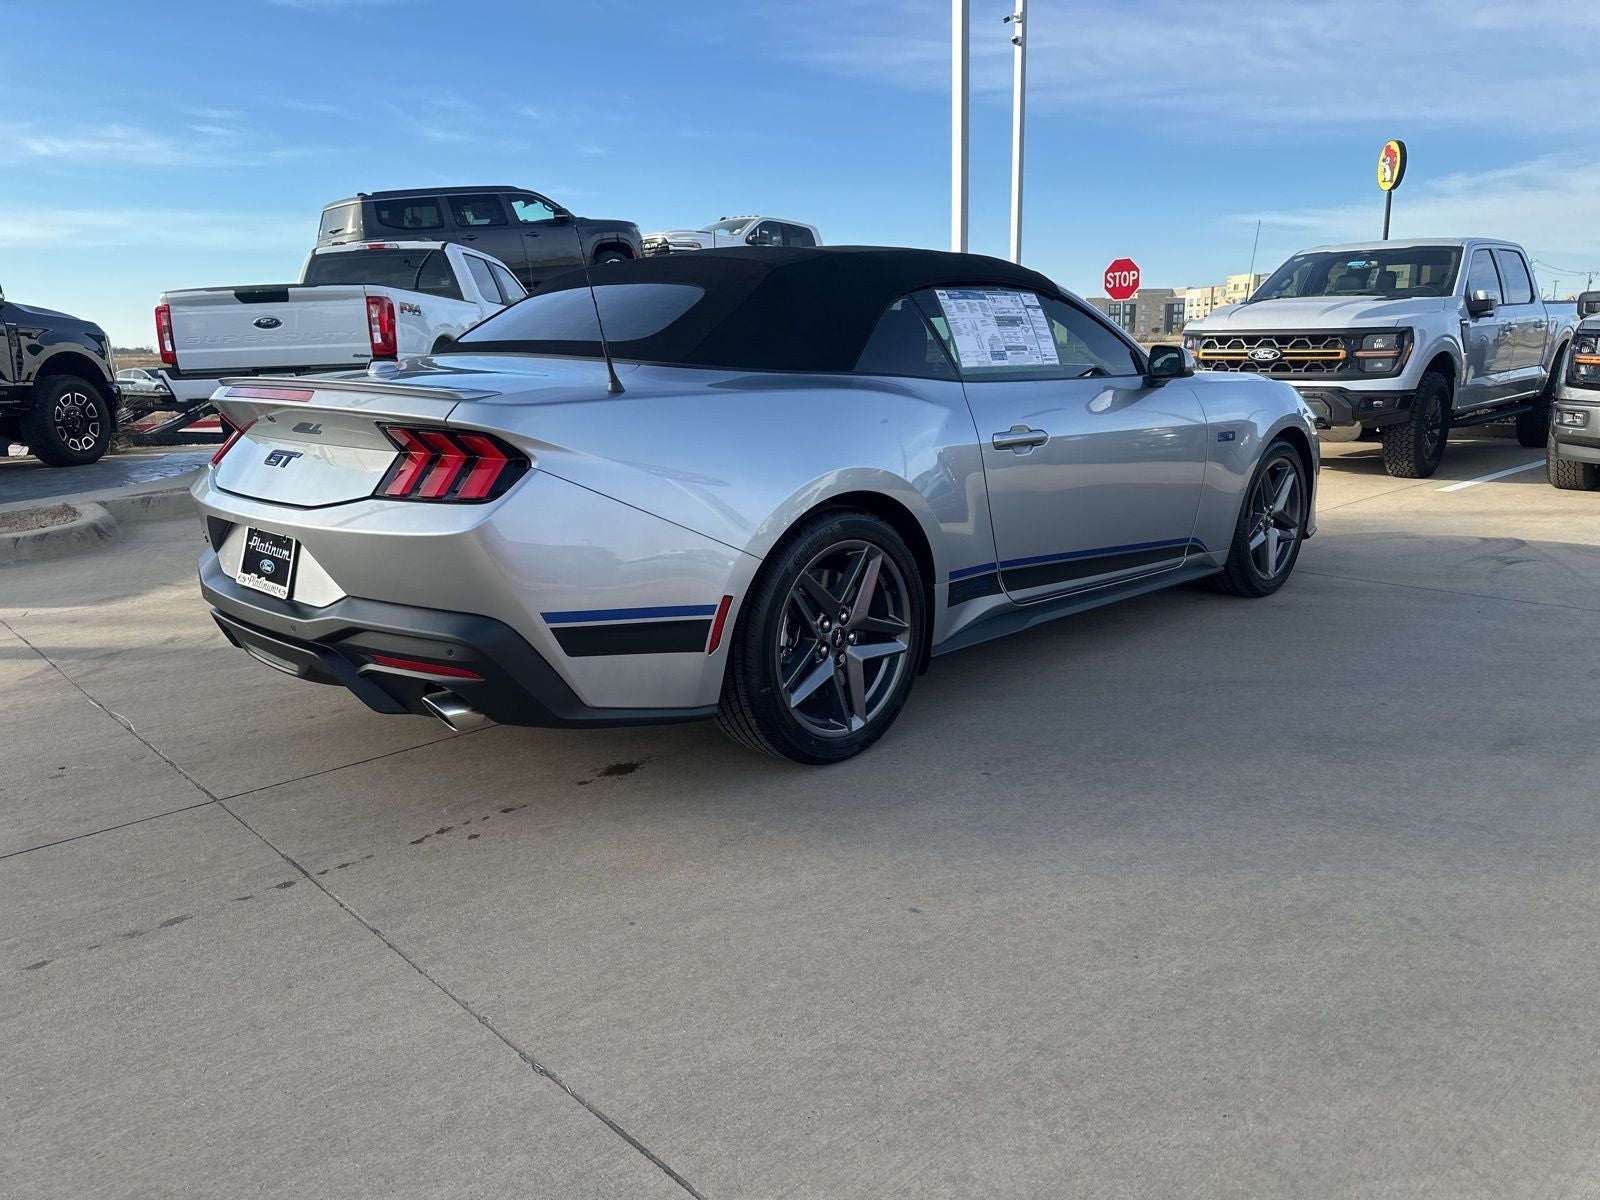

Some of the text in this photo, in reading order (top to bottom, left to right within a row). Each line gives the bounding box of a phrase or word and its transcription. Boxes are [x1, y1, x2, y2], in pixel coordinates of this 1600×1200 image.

[1106, 270, 1138, 288] STOP
[399, 301, 421, 314] FX4
[184, 331, 359, 344] SUPER DUTY
[1254, 350, 1276, 359] Ford
[264, 449, 304, 468] GT
[248, 535, 292, 561] Platinum
